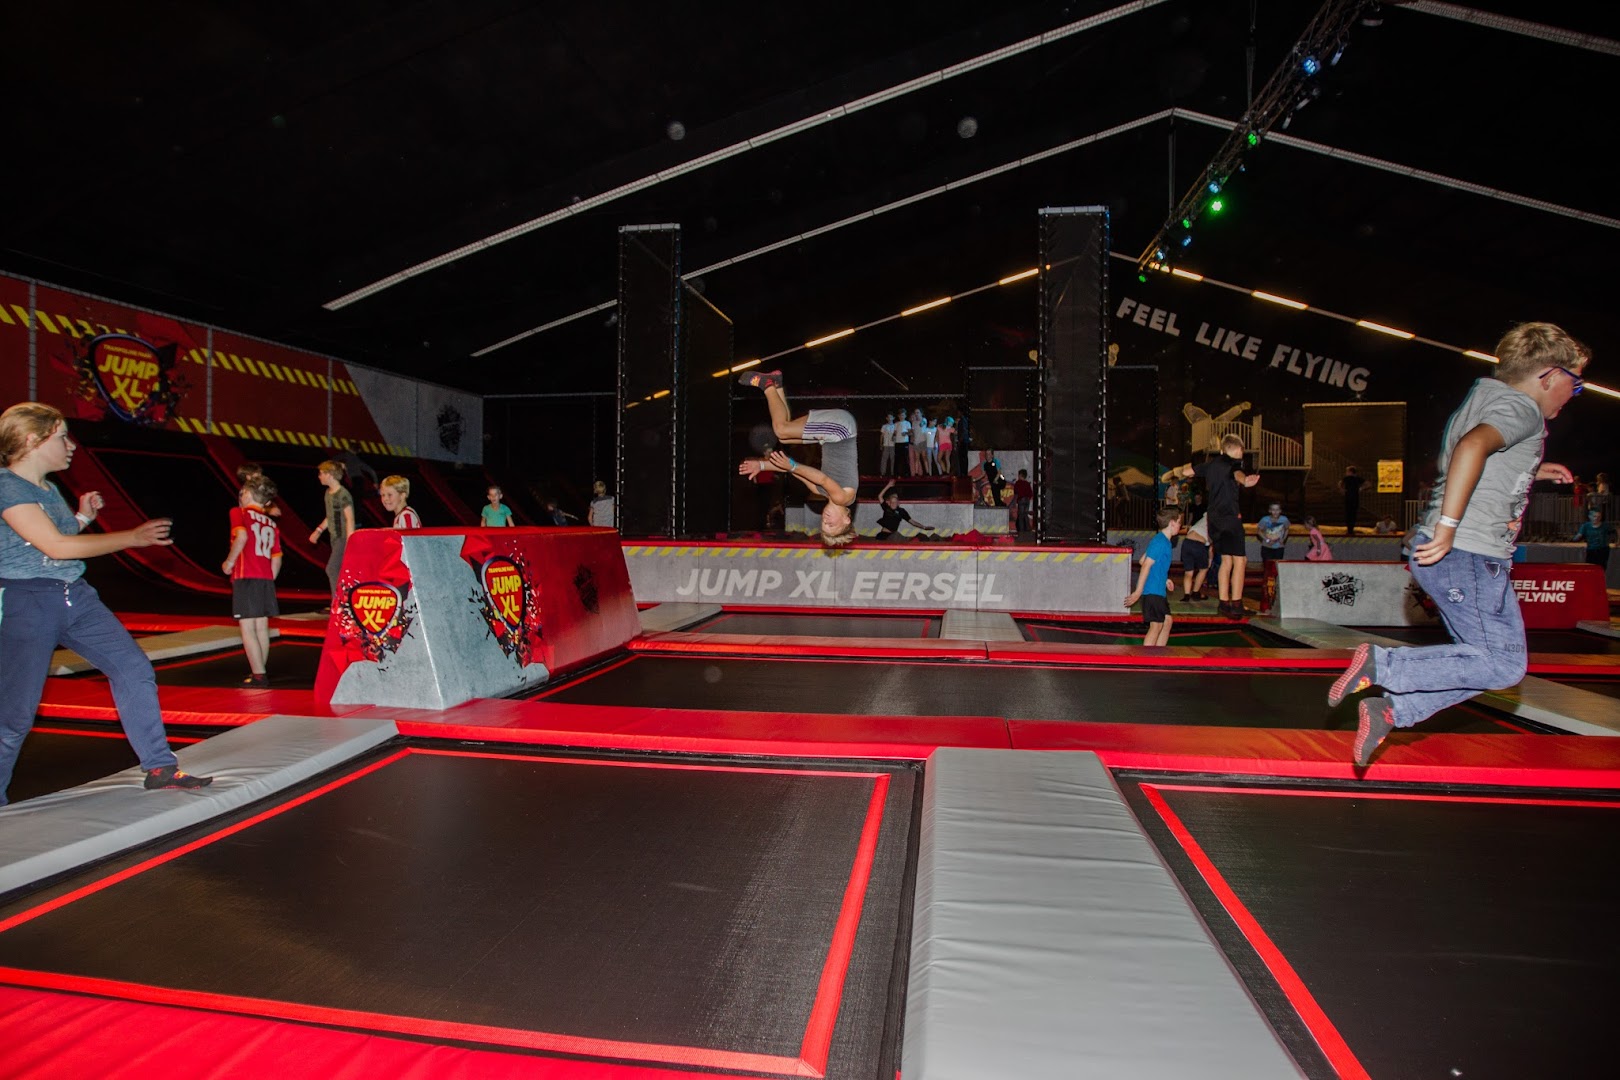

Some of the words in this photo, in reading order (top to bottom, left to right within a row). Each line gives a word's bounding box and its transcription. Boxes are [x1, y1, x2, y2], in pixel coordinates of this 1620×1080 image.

[1116, 297, 1181, 337] FEEL
[1195, 321, 1263, 361] LIKE
[1270, 343, 1371, 392] FLYING
[98, 354, 159, 380] JUMP
[110, 375, 144, 409] XL
[251, 522, 275, 559] 10
[490, 575, 522, 595] JUMP
[676, 569, 783, 596] JUMP
[788, 570, 839, 599] XL
[850, 571, 1004, 602] EERSEL
[1511, 579, 1540, 591] EEL
[1542, 580, 1576, 592] LIKE
[1516, 591, 1567, 603] FLYING
[353, 595, 397, 610] JUMP
[500, 595, 520, 624] XL
[362, 609, 386, 632] XL
